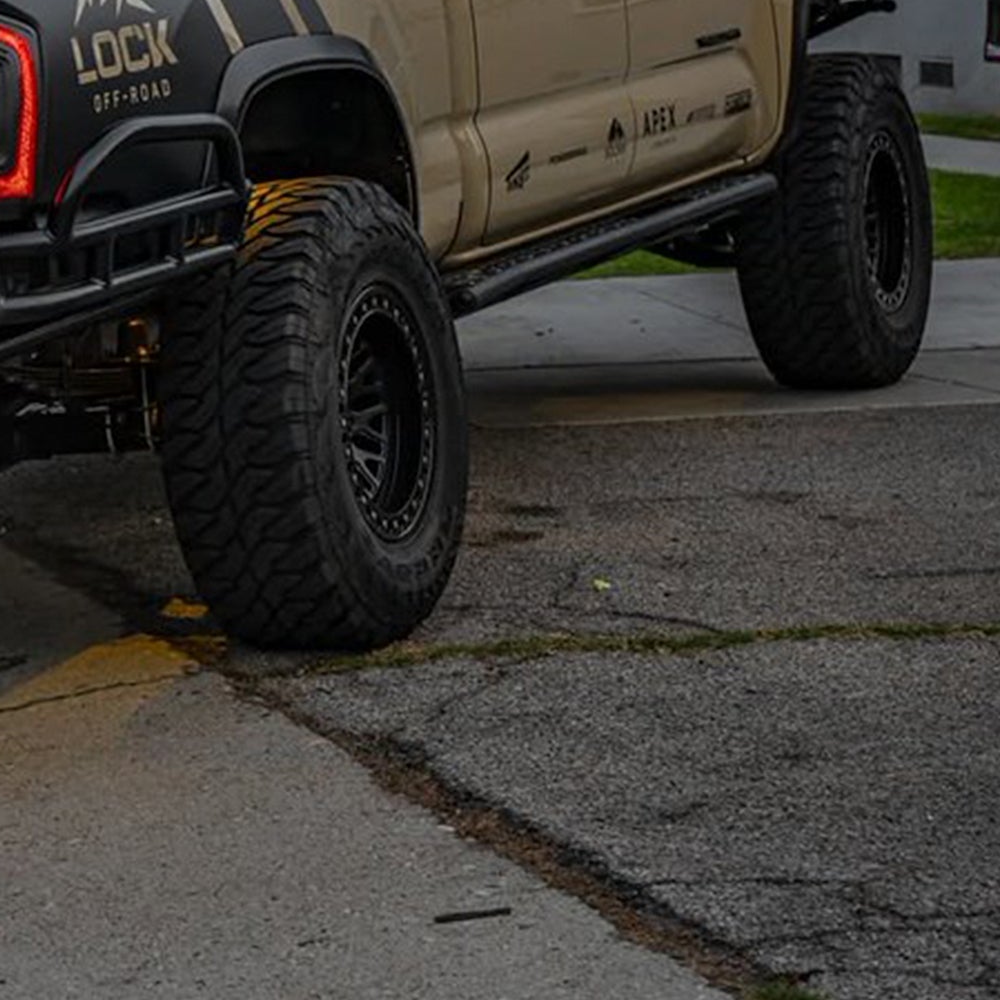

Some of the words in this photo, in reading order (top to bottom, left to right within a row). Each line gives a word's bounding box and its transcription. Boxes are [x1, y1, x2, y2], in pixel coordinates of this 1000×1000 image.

[70, 18, 178, 85] LOCK
[92, 78, 173, 114] OFF-ROAD
[643, 100, 677, 137] APEX
